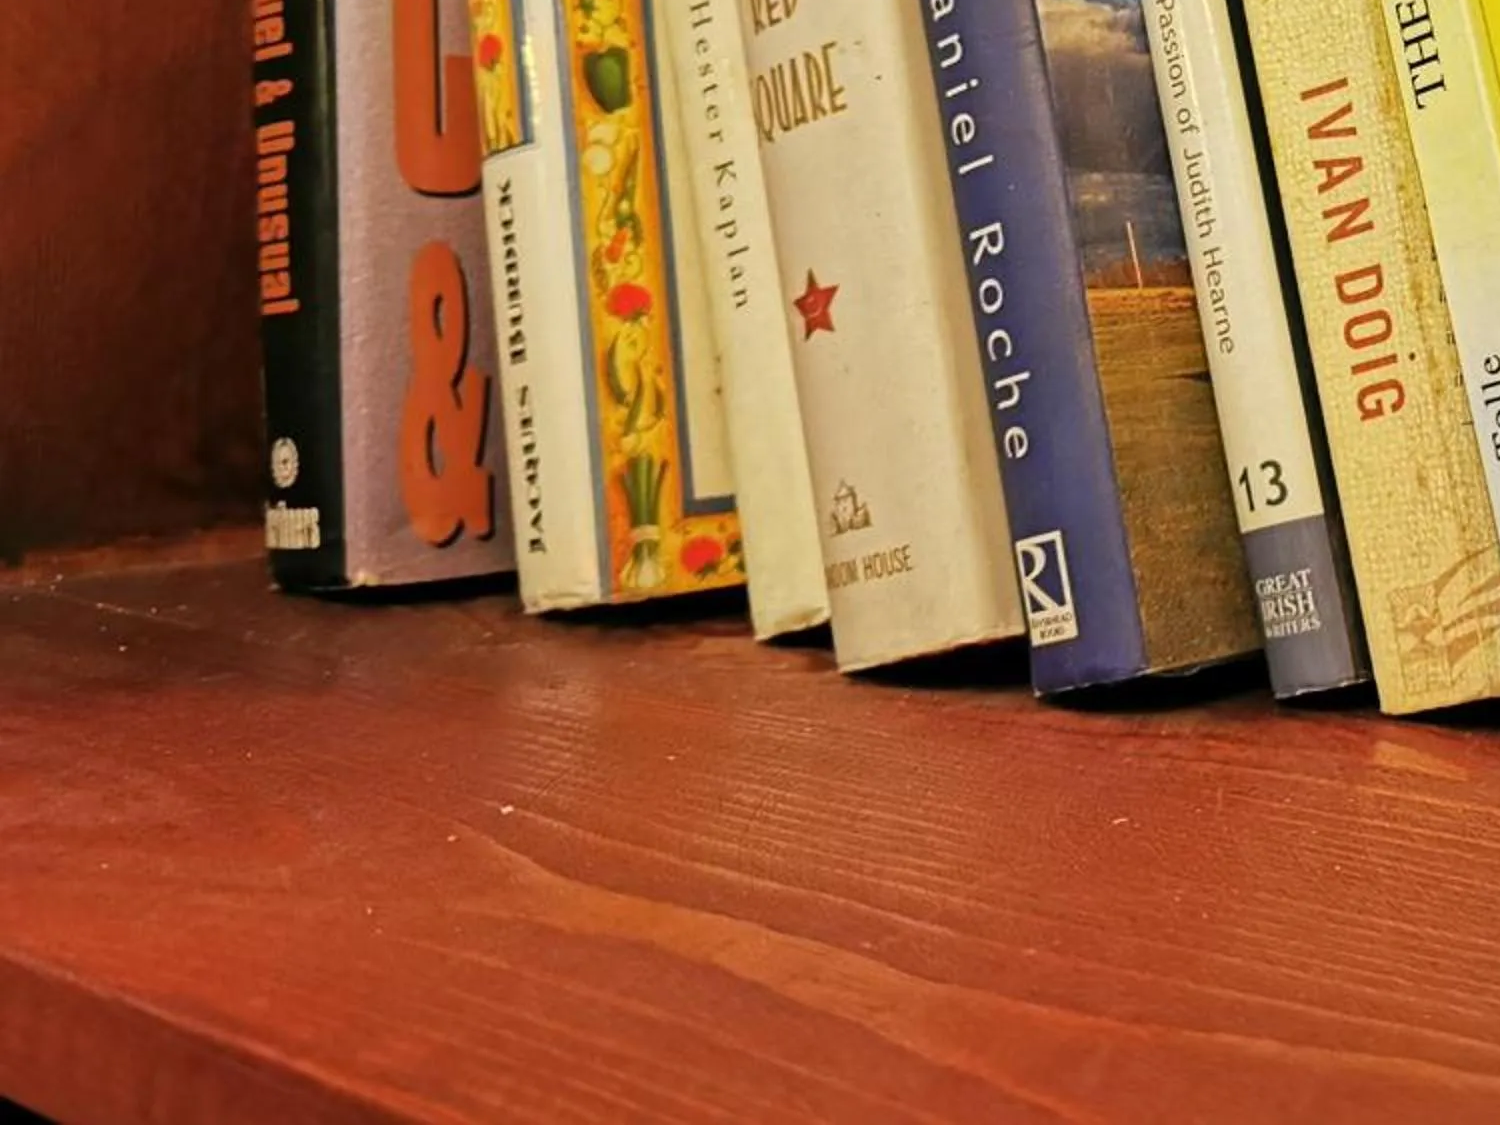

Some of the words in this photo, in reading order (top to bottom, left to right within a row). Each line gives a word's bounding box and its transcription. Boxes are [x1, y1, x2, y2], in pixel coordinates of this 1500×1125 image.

[255, 80, 295, 104] &
[752, 41, 848, 143] QUARE
[1176, 106, 1201, 135] of
[690, 0, 724, 143] Hester
[713, 159, 750, 312] Kaplan
[1183, 147, 1217, 239] Judith
[1300, 77, 1375, 244] IVAN
[257, 120, 300, 317] Unusual
[969, 221, 1031, 460] Roche
[1203, 246, 1236, 356] Hearne
[1334, 263, 1407, 422] DOIG
[1238, 459, 1289, 513] 13
[864, 544, 916, 579] HOUSE
[1255, 568, 1313, 597] GREAT
[1261, 589, 1316, 622] IRISH
